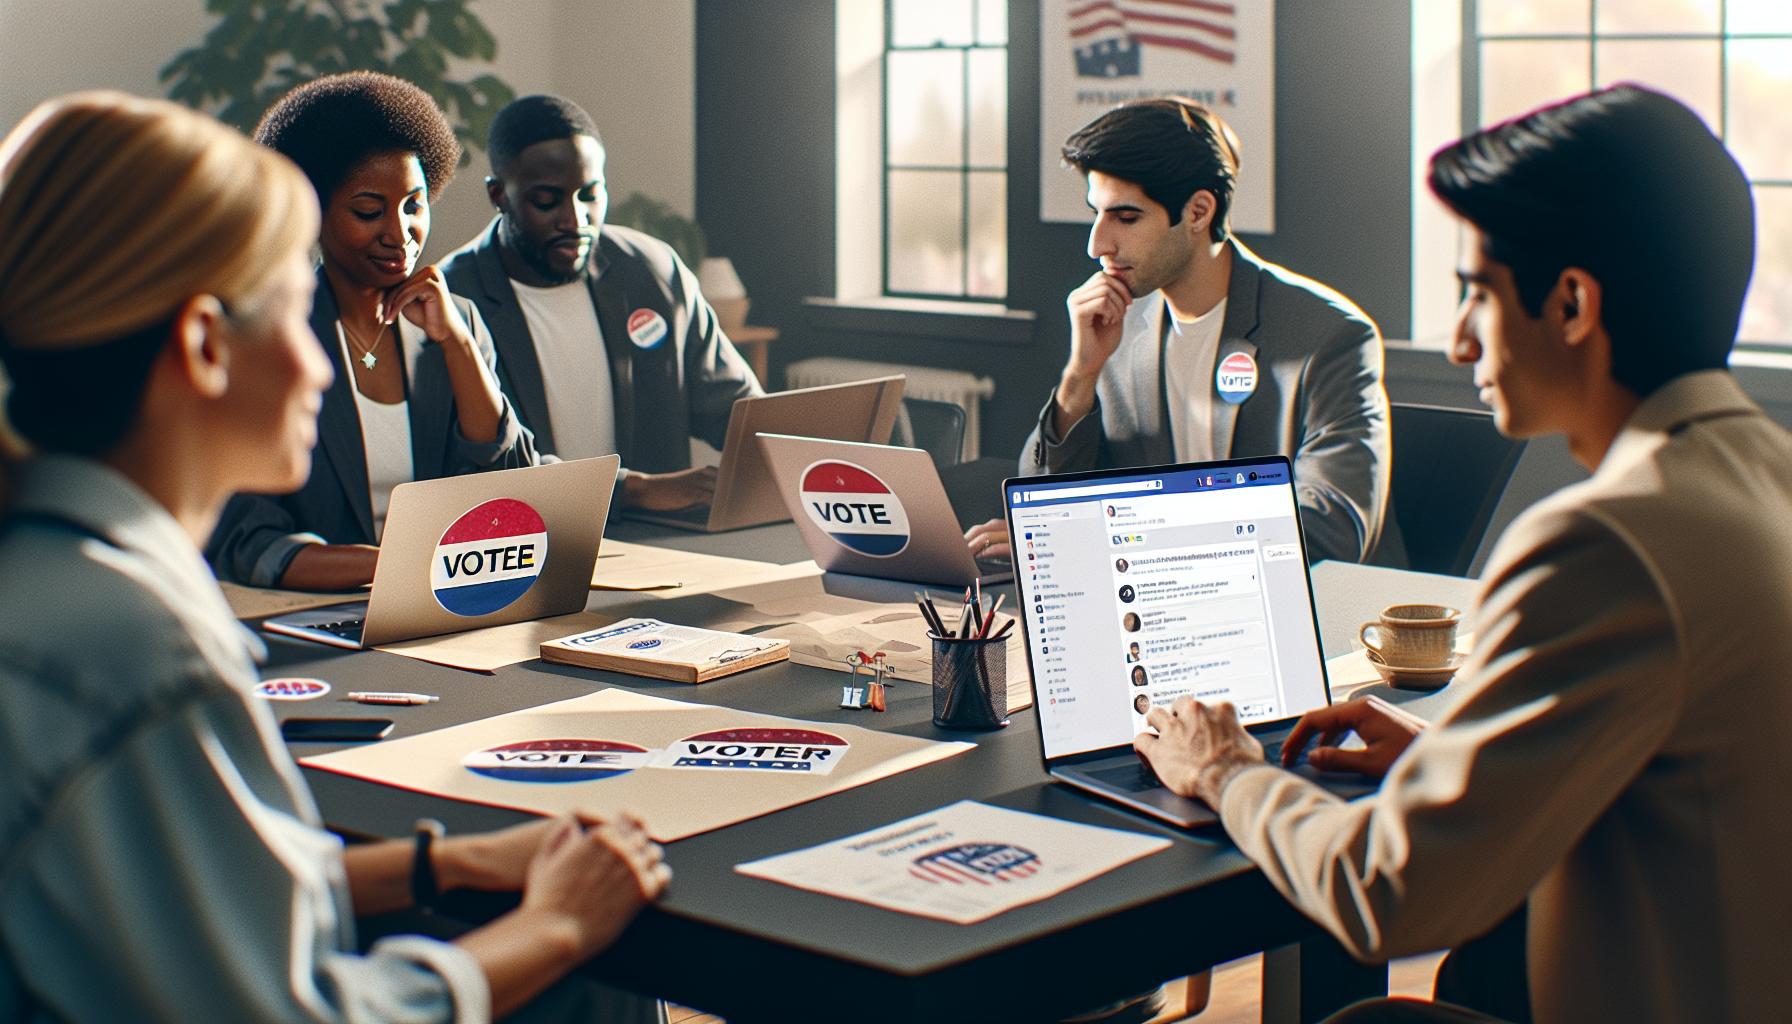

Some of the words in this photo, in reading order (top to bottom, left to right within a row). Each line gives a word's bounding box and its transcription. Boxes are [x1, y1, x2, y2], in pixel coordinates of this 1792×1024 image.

[812, 502, 892, 525] VOTE
[443, 544, 535, 579] VOTEE
[496, 753, 623, 764] VOTE
[688, 743, 832, 761] VOTER
